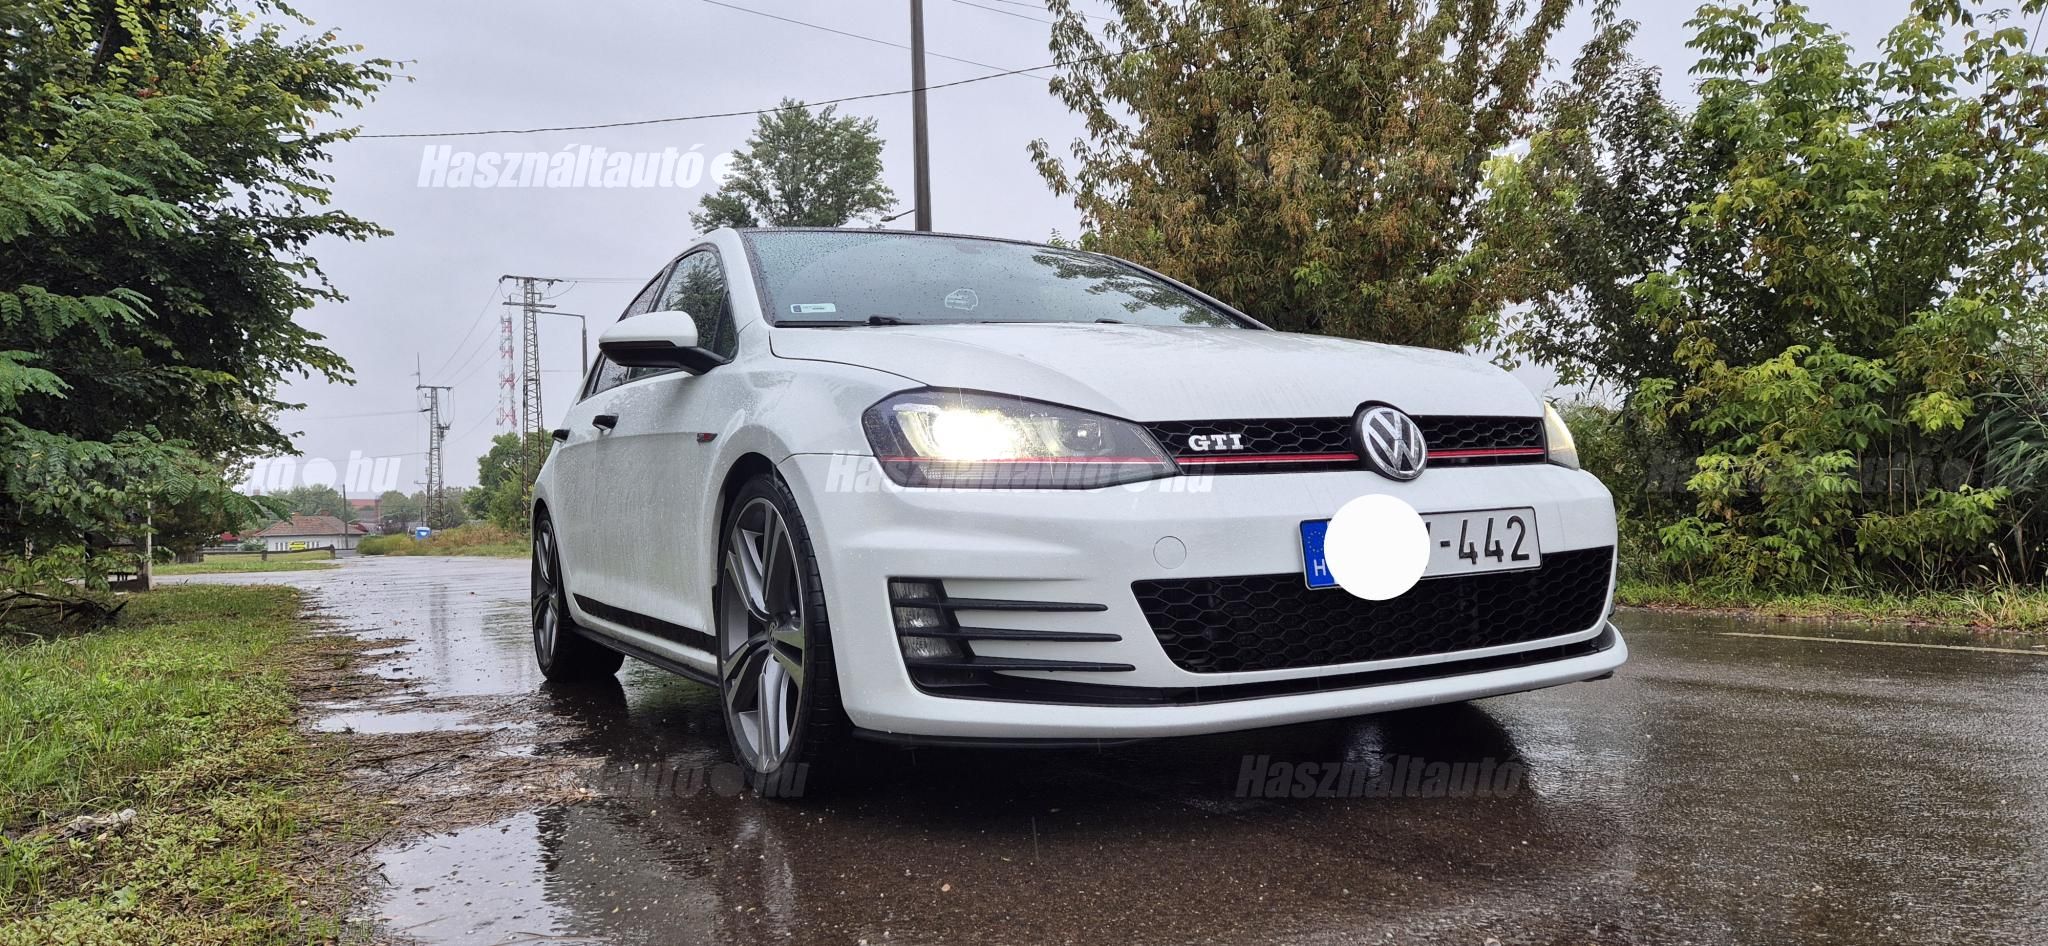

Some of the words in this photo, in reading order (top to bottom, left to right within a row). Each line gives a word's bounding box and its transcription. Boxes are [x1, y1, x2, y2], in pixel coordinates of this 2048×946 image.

[1188, 433, 1244, 451] GTI
[1426, 515, 1530, 568] -442
[1313, 558, 1327, 577] H
